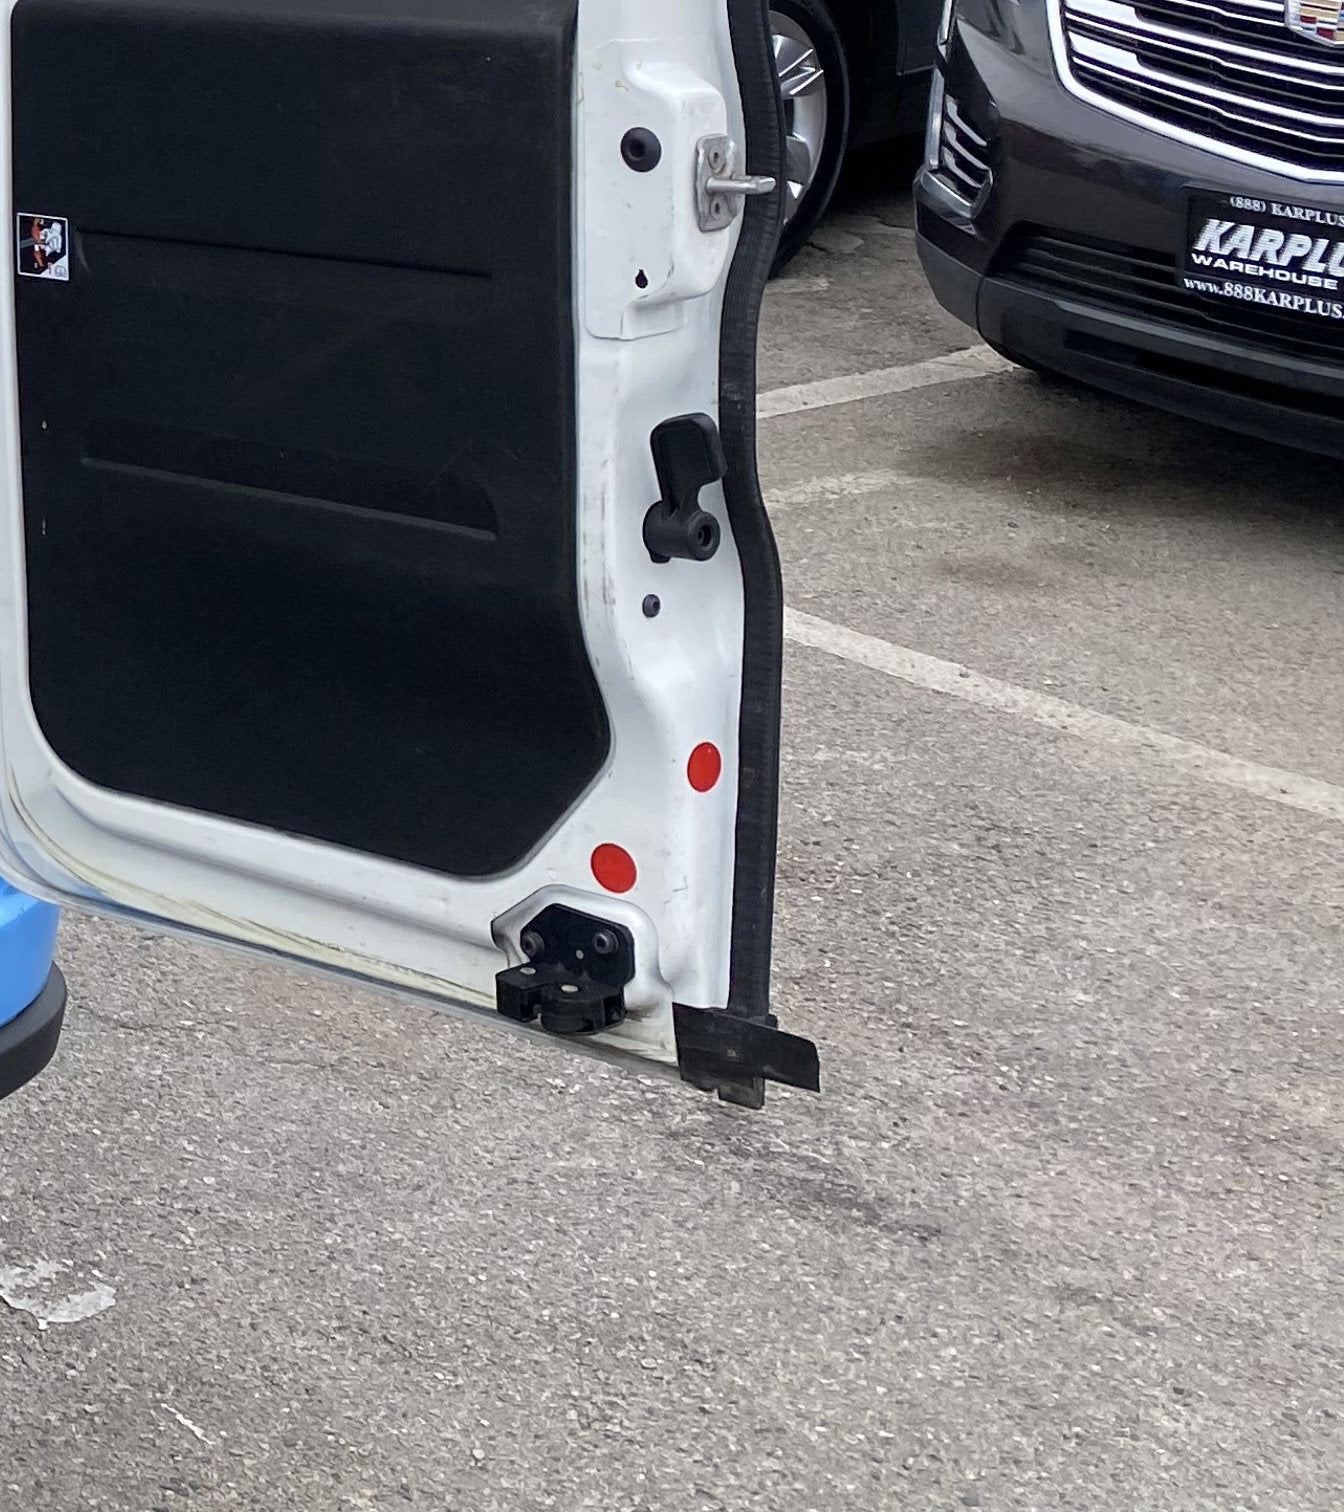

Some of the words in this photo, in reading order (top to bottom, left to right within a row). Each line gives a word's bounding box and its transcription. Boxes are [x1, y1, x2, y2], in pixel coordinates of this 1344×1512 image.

[1230, 196, 1266, 213] (888)
[1271, 202, 1344, 228] KARPLUS
[1191, 253, 1339, 290] WAREHOUSE
